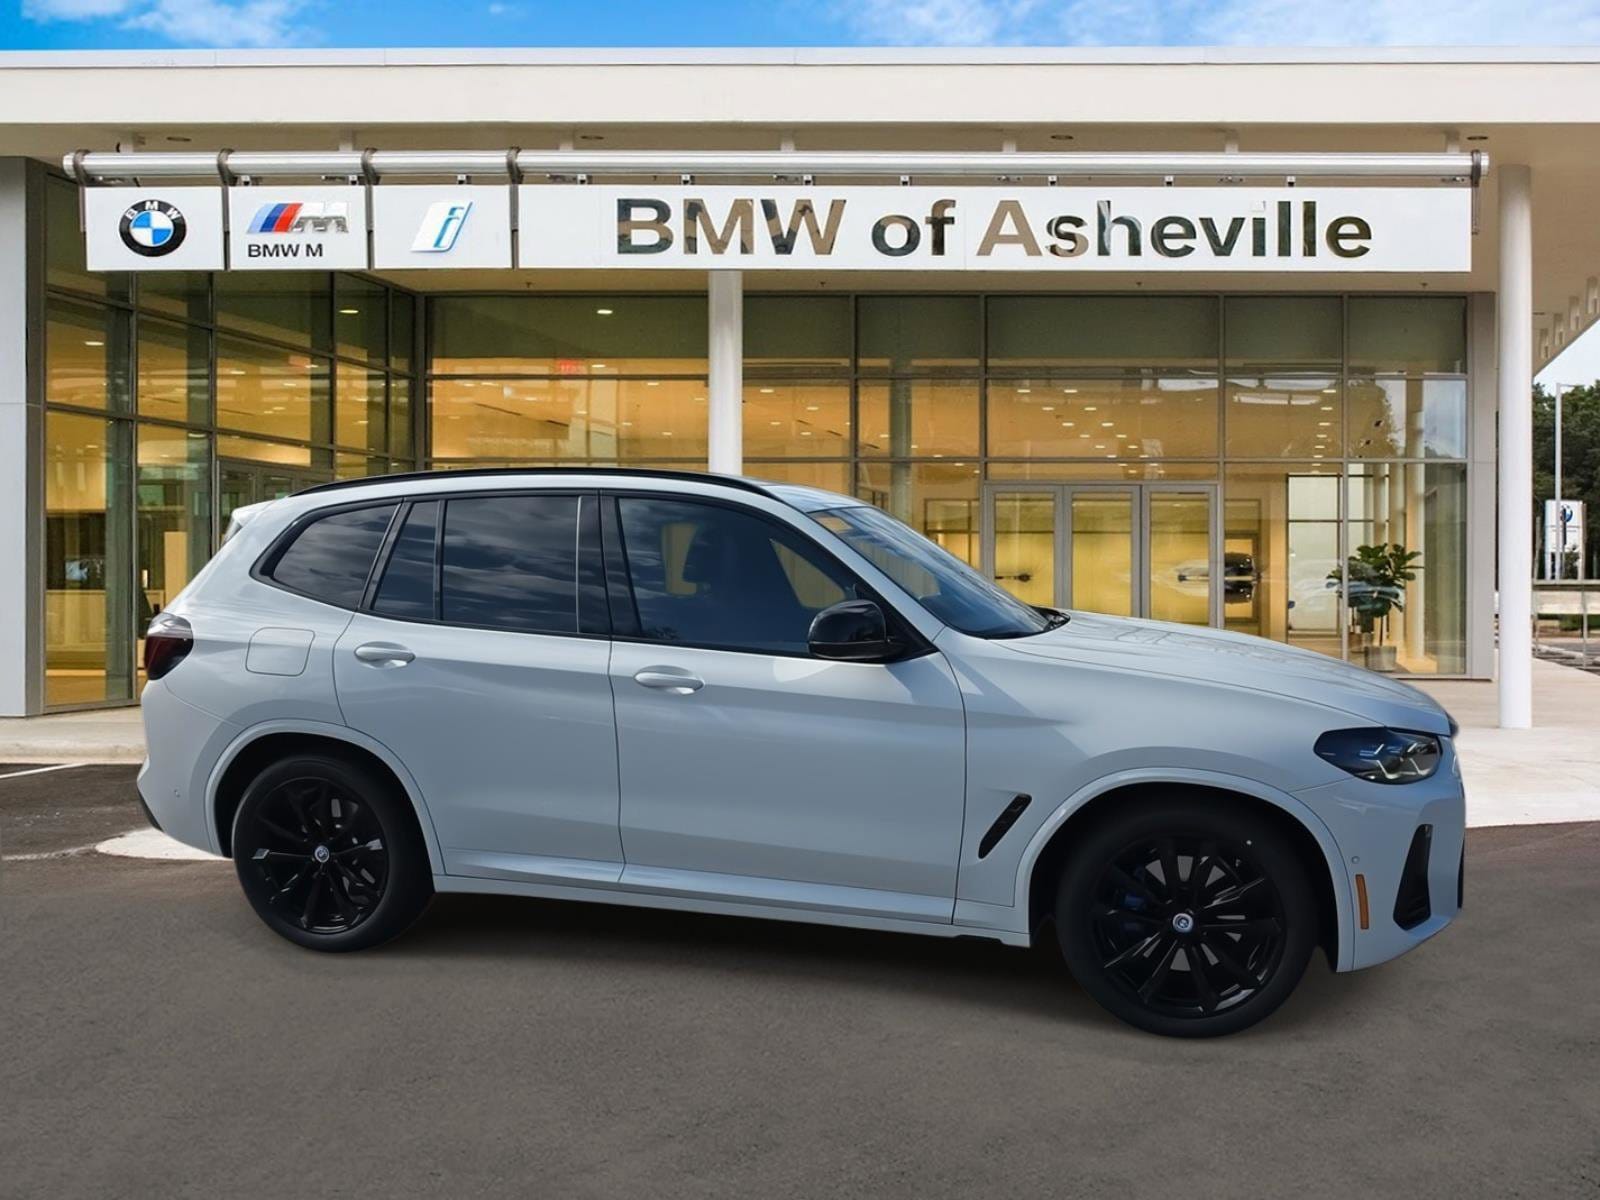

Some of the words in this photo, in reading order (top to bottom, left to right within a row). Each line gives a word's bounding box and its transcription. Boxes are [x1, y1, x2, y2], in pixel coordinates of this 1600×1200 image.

[125, 201, 181, 220] BMW
[616, 198, 846, 255] BMW
[871, 199, 956, 257] of
[976, 199, 1372, 258] Asheville
[248, 243, 300, 258] BMW
[305, 243, 323, 257] M
